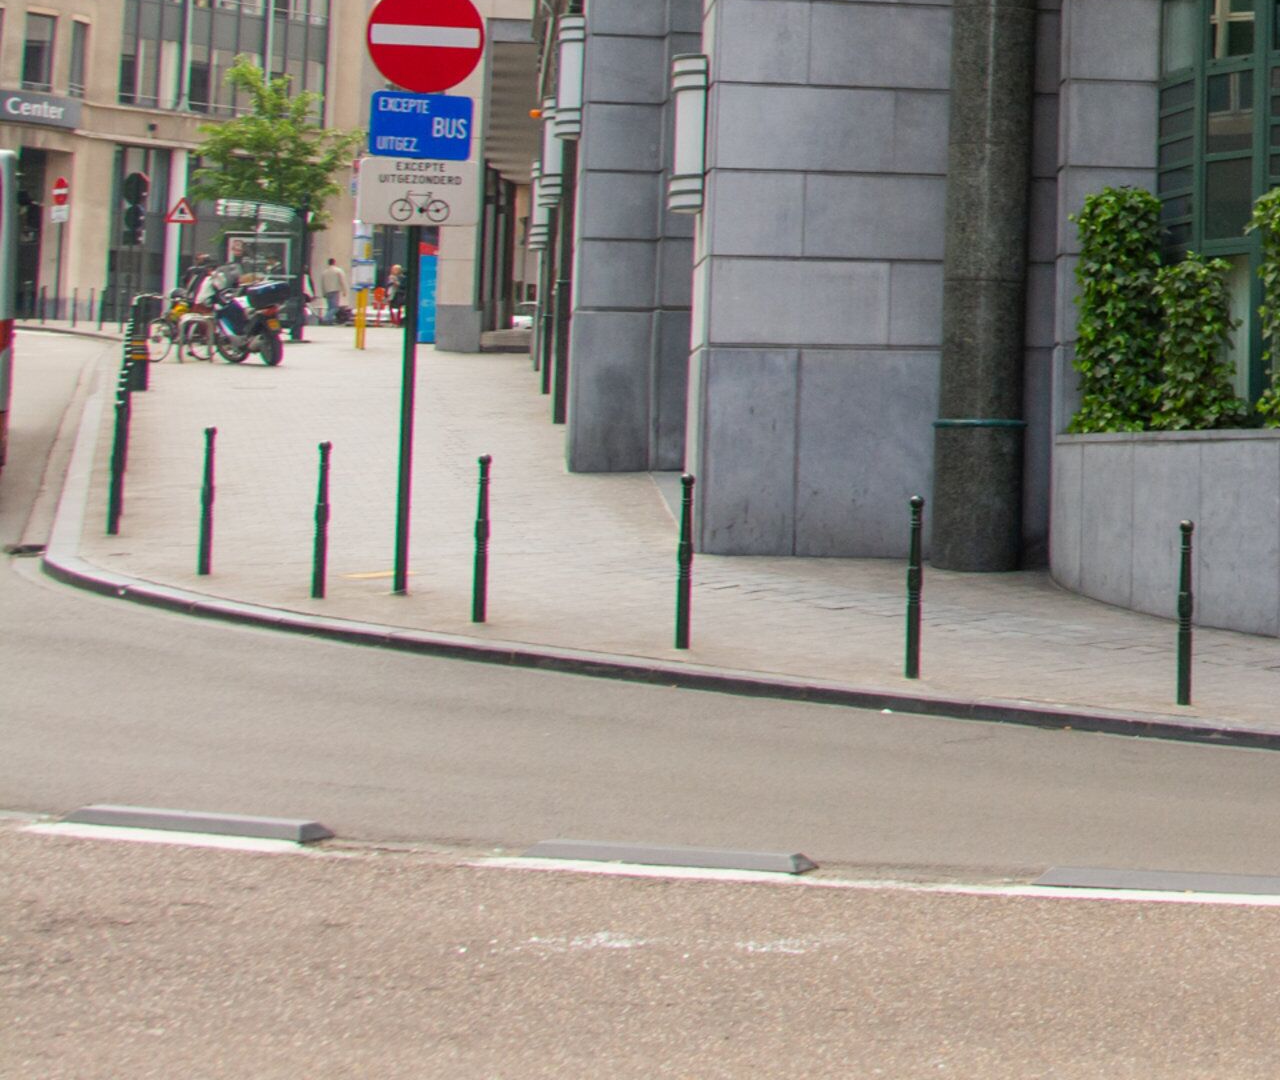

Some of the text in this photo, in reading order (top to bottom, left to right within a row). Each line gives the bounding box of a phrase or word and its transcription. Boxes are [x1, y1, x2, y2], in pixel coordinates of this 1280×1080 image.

[6, 97, 65, 119] Center
[378, 97, 430, 114] EXCEPTE
[432, 117, 467, 139] BUS
[396, 162, 445, 172] EXCEPTE
